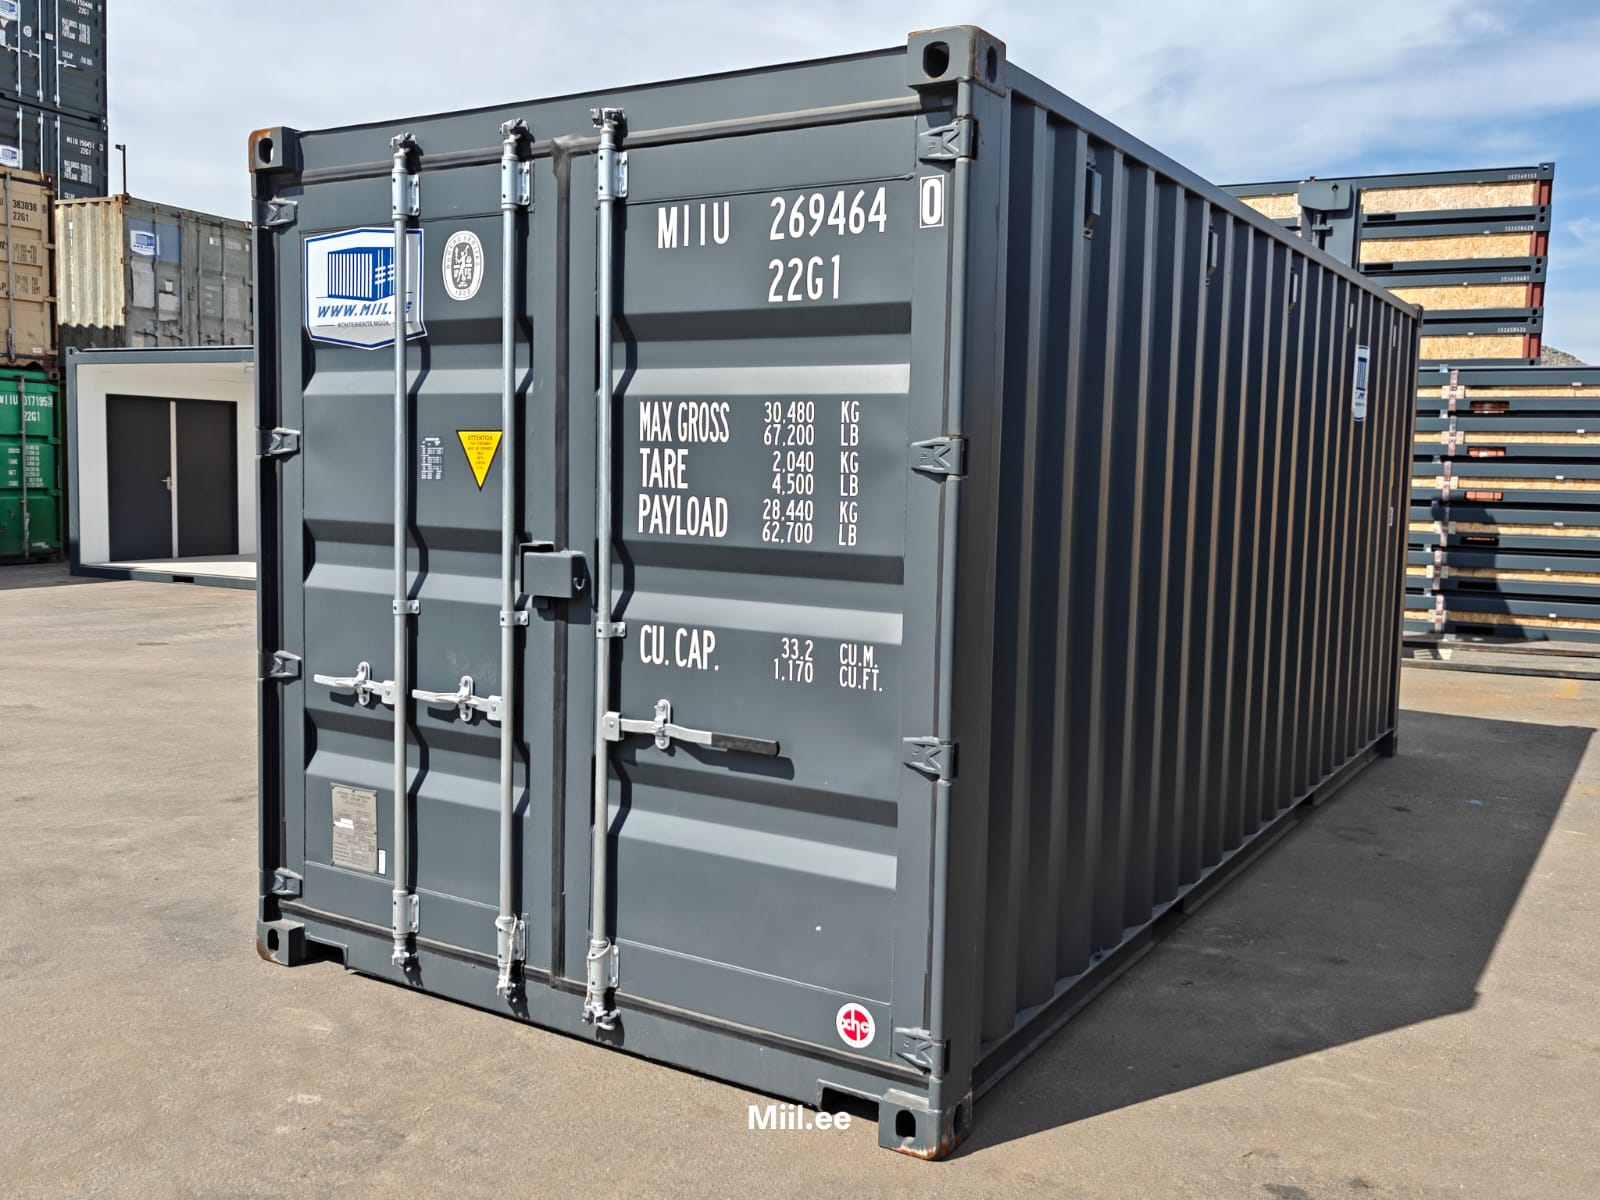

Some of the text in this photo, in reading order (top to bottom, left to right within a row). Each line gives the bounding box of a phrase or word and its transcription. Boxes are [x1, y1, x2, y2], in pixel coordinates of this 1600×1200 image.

[657, 175, 944, 249] MIIU 269464 0
[767, 254, 841, 302] 22G1
[317, 301, 413, 319] WWW.MIIL.
[639, 400, 861, 443] MAX GROSS 30,480 KG
[763, 424, 860, 447] 67,200 LB
[639, 448, 860, 489] TARE 2,040 KG
[771, 473, 859, 497] 4,500 LB
[638, 494, 858, 538] PAYLOAD 28,440 KG
[761, 521, 857, 546] 62,700 LB
[640, 624, 879, 671] CU. CAP. 33.2 CU.M.
[839, 666, 883, 692] CU.FT.
